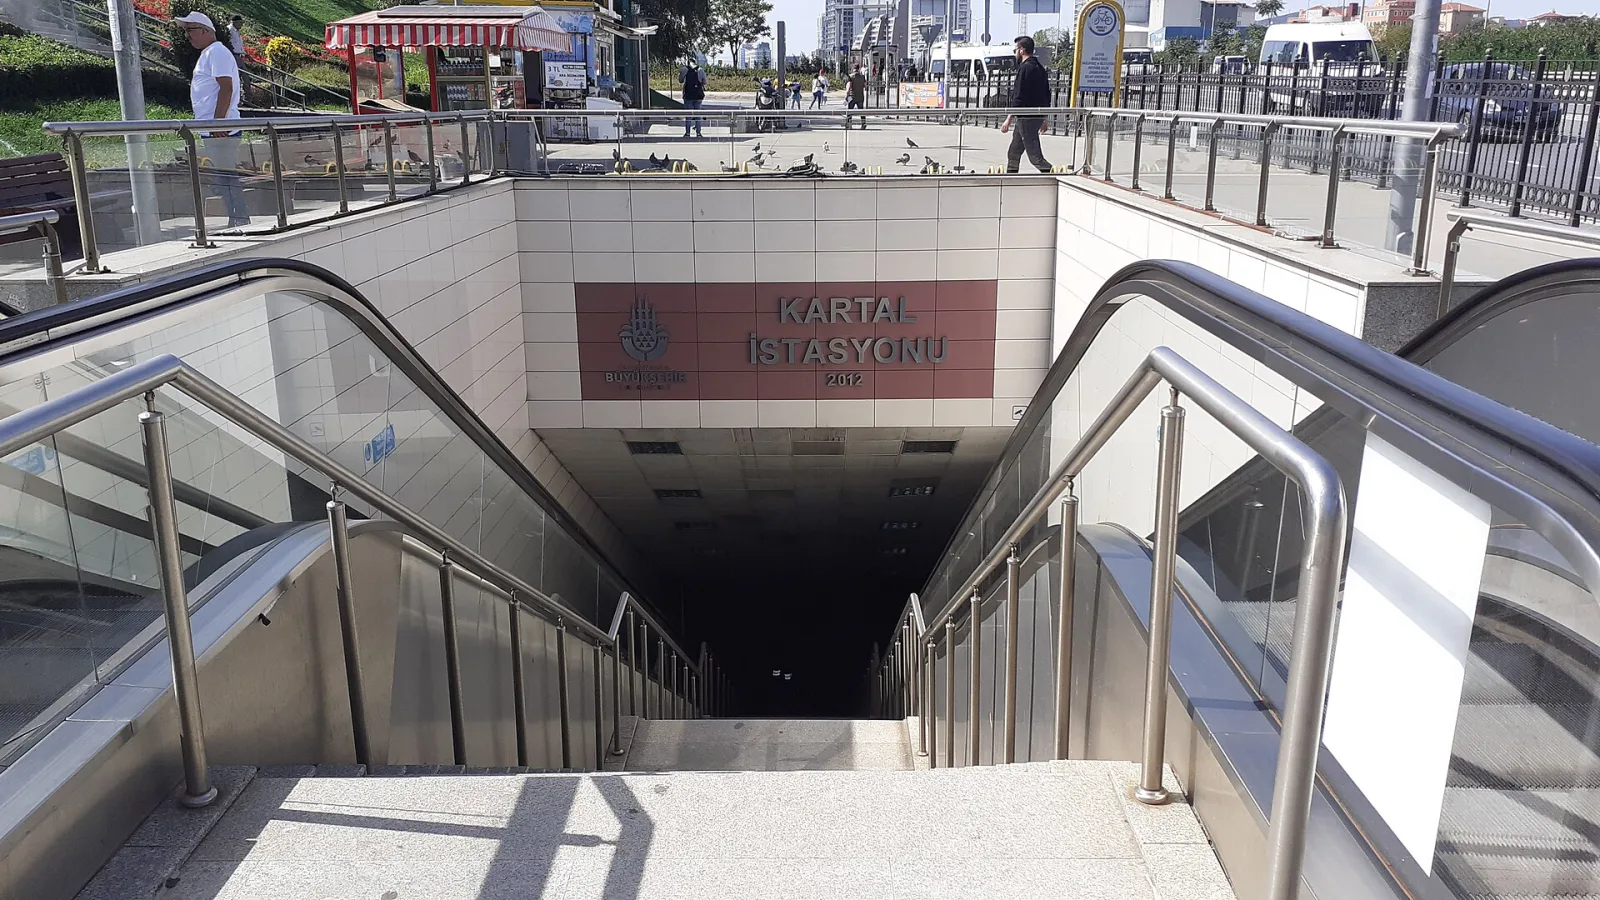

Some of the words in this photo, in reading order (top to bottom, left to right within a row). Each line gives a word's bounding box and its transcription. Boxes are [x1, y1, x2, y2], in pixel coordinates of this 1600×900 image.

[780, 296, 917, 324] KARTAL
[749, 332, 948, 364] İSTASYONU
[826, 373, 864, 387] 2012
